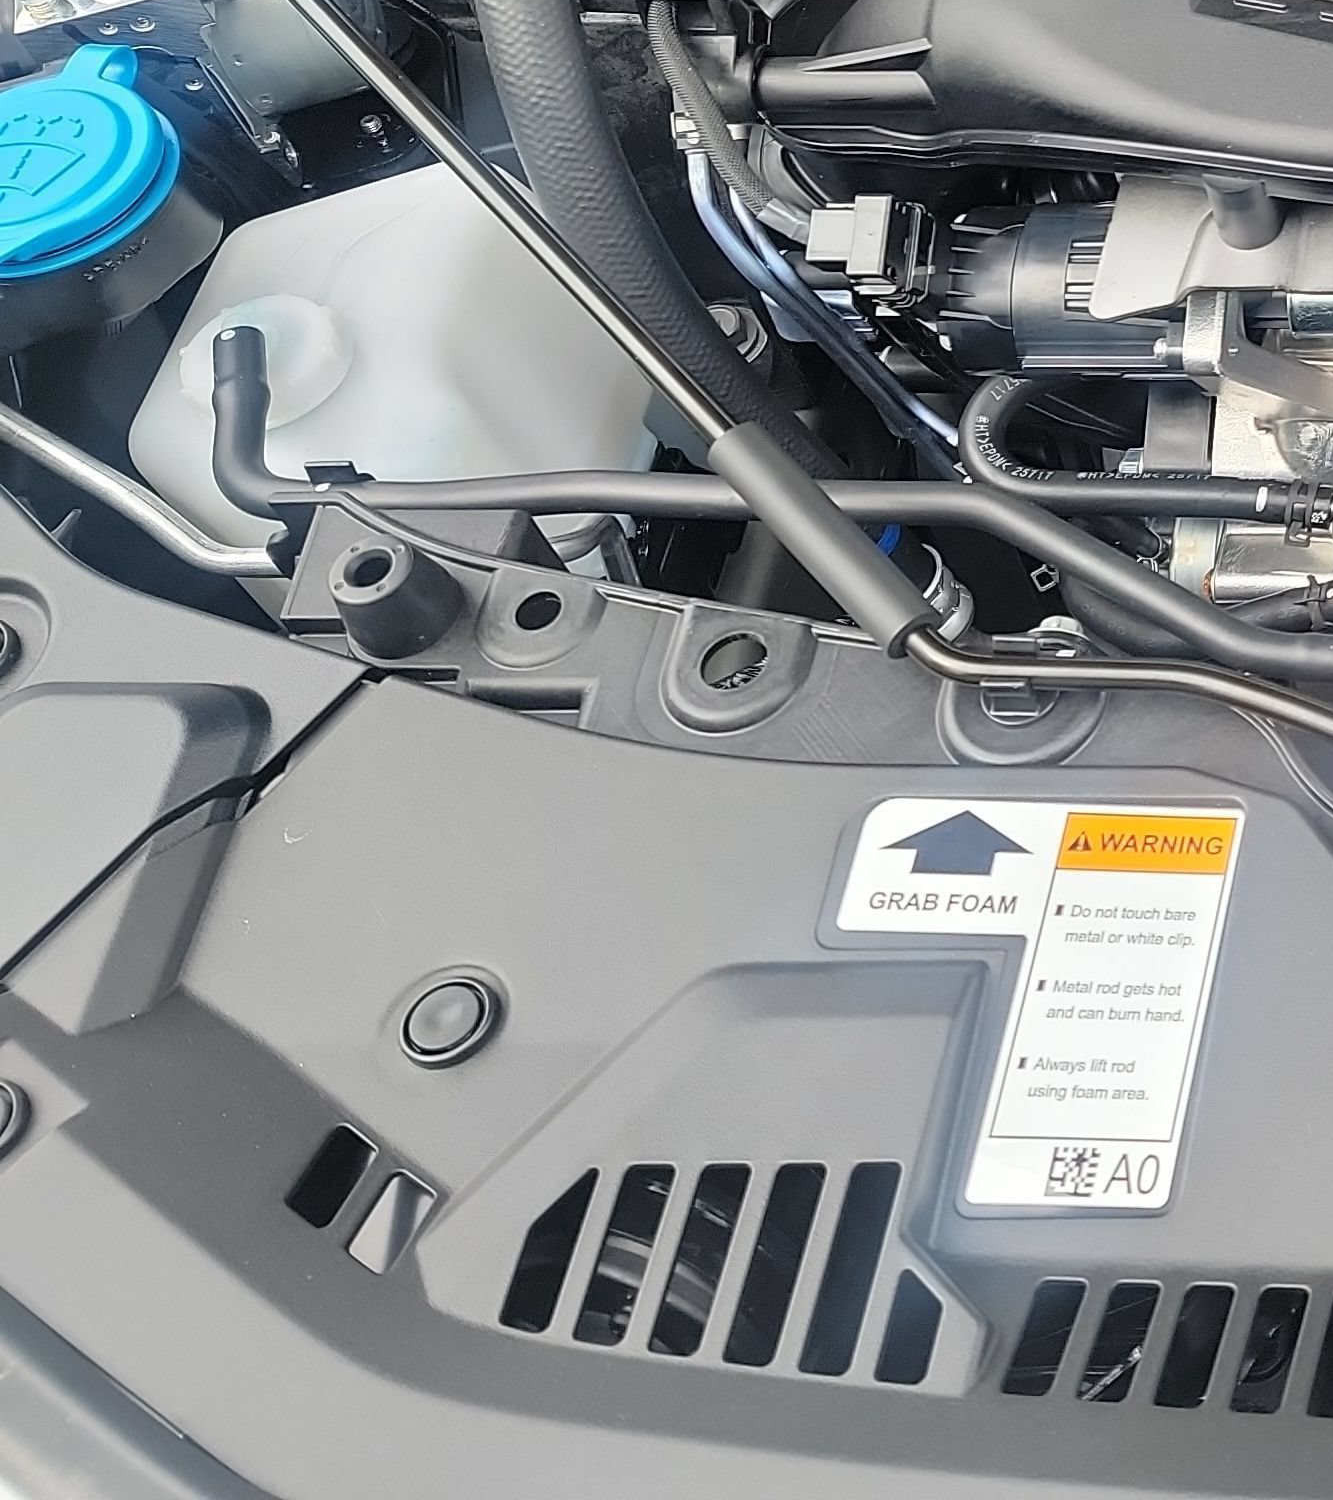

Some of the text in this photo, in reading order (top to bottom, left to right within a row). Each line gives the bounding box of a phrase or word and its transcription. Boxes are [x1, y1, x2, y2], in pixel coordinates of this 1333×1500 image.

[1100, 832, 1223, 856] WARNING
[869, 891, 1018, 915] GRAB FOAM
[1070, 904, 1197, 922] Do not touch bare
[1064, 930, 1195, 948] metal or white clip.
[1053, 980, 1182, 998] Metal rod gets hot
[1046, 1006, 1184, 1022] and can burn hand.
[1033, 1057, 1135, 1074] Always lift rod
[1027, 1085, 1149, 1102] using foam area.
[1103, 1153, 1161, 1195] A0
